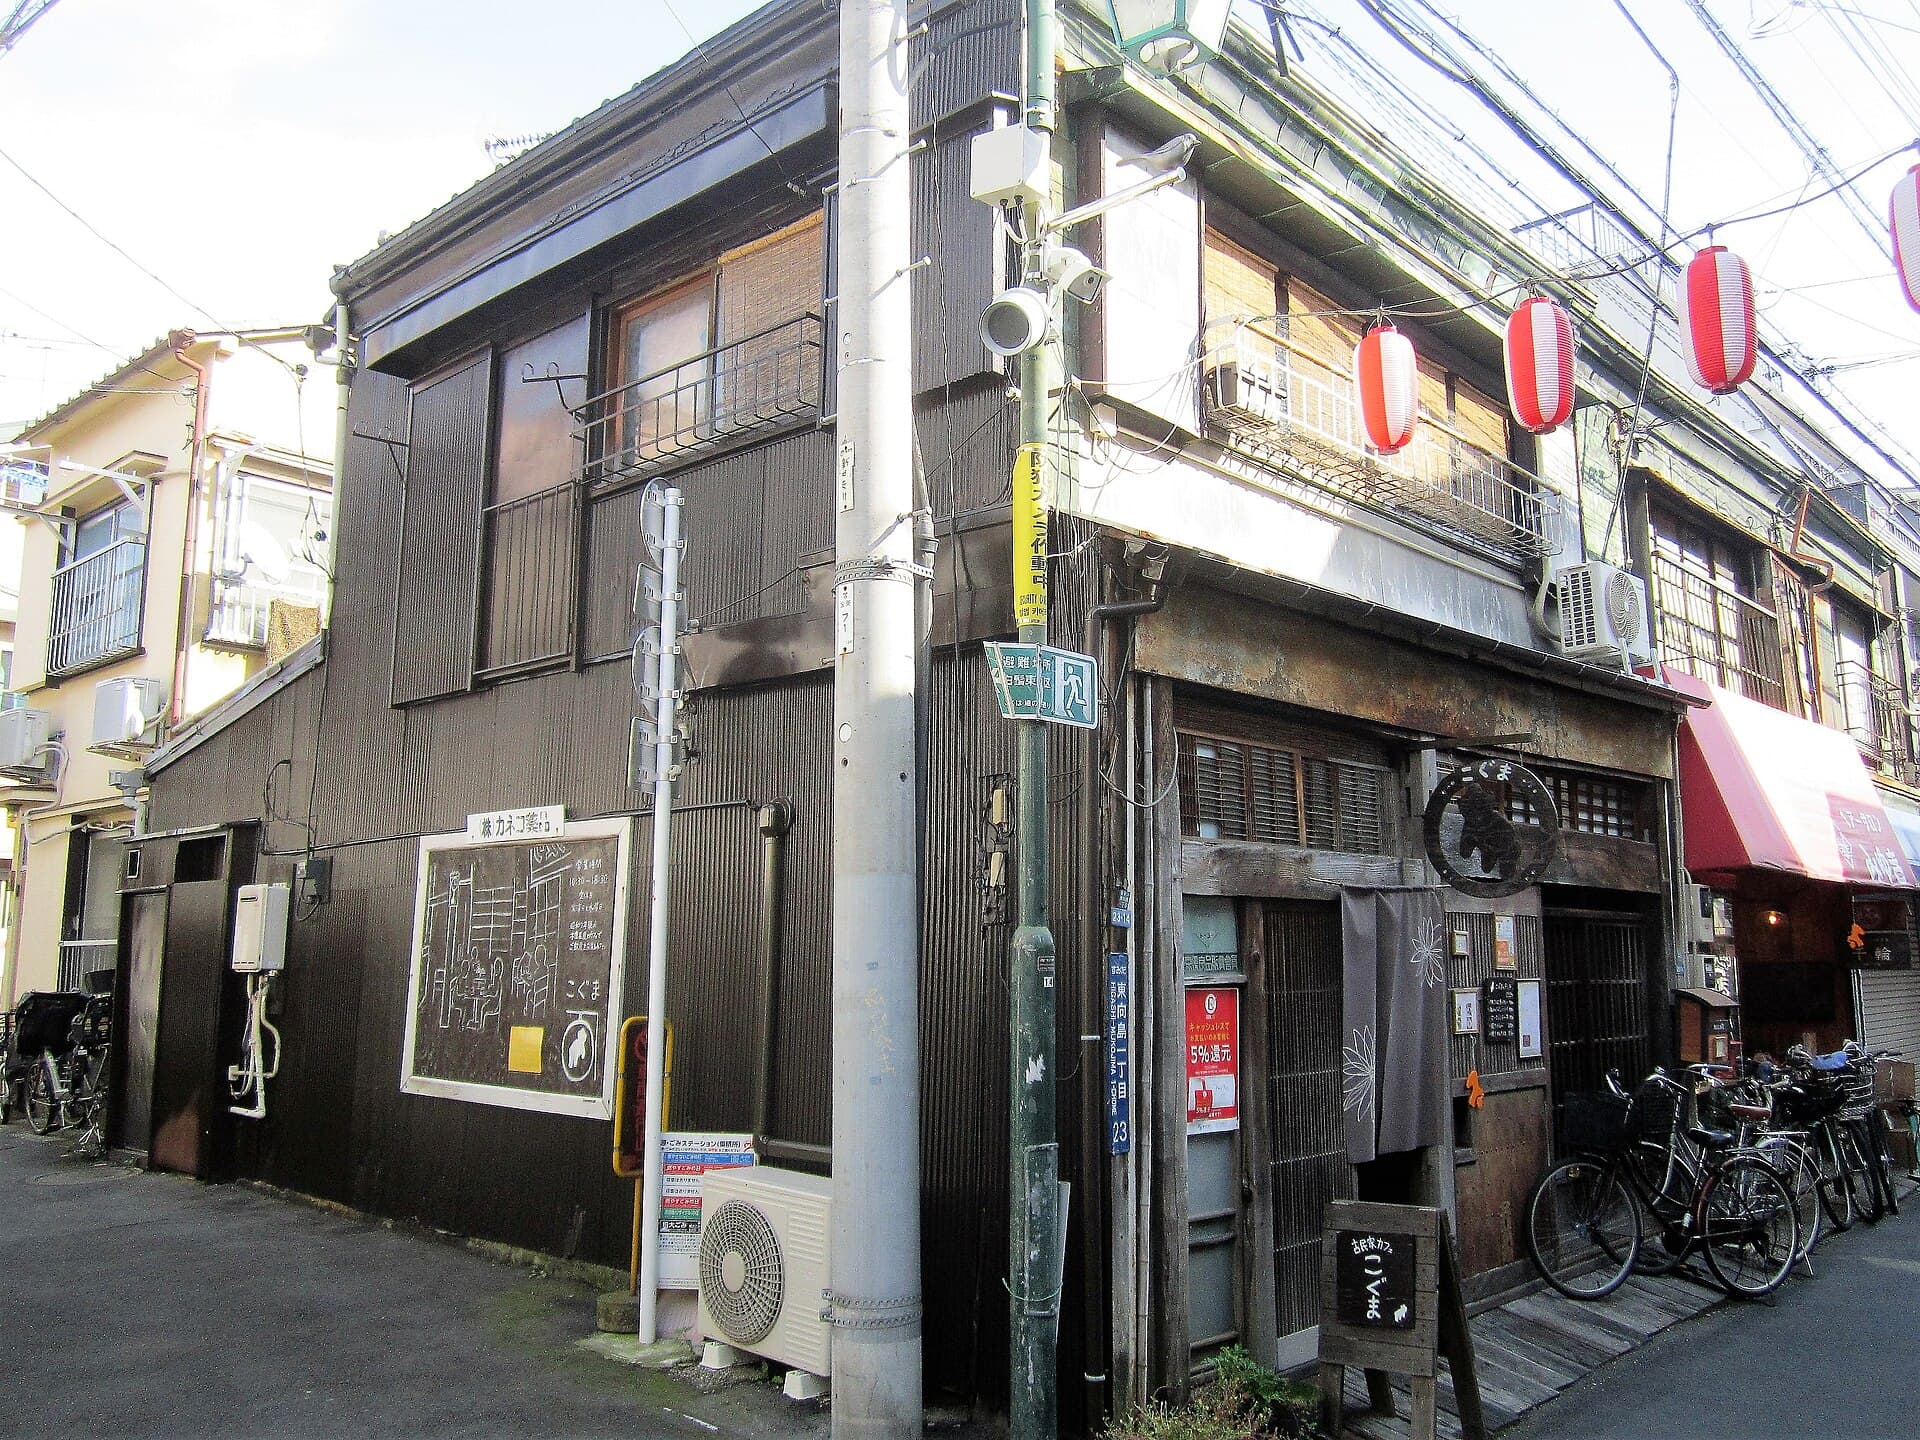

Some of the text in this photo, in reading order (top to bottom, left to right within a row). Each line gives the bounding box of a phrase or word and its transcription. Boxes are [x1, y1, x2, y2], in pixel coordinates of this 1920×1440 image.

[1461, 760, 1513, 782] こぐま
[566, 980, 600, 1000] こぐま
[1117, 982, 1127, 1099] 東向島一丁目
[1190, 1044, 1232, 1064] 5%還元
[1113, 1121, 1127, 1143] 23
[1364, 1254, 1387, 1320] こぐま
